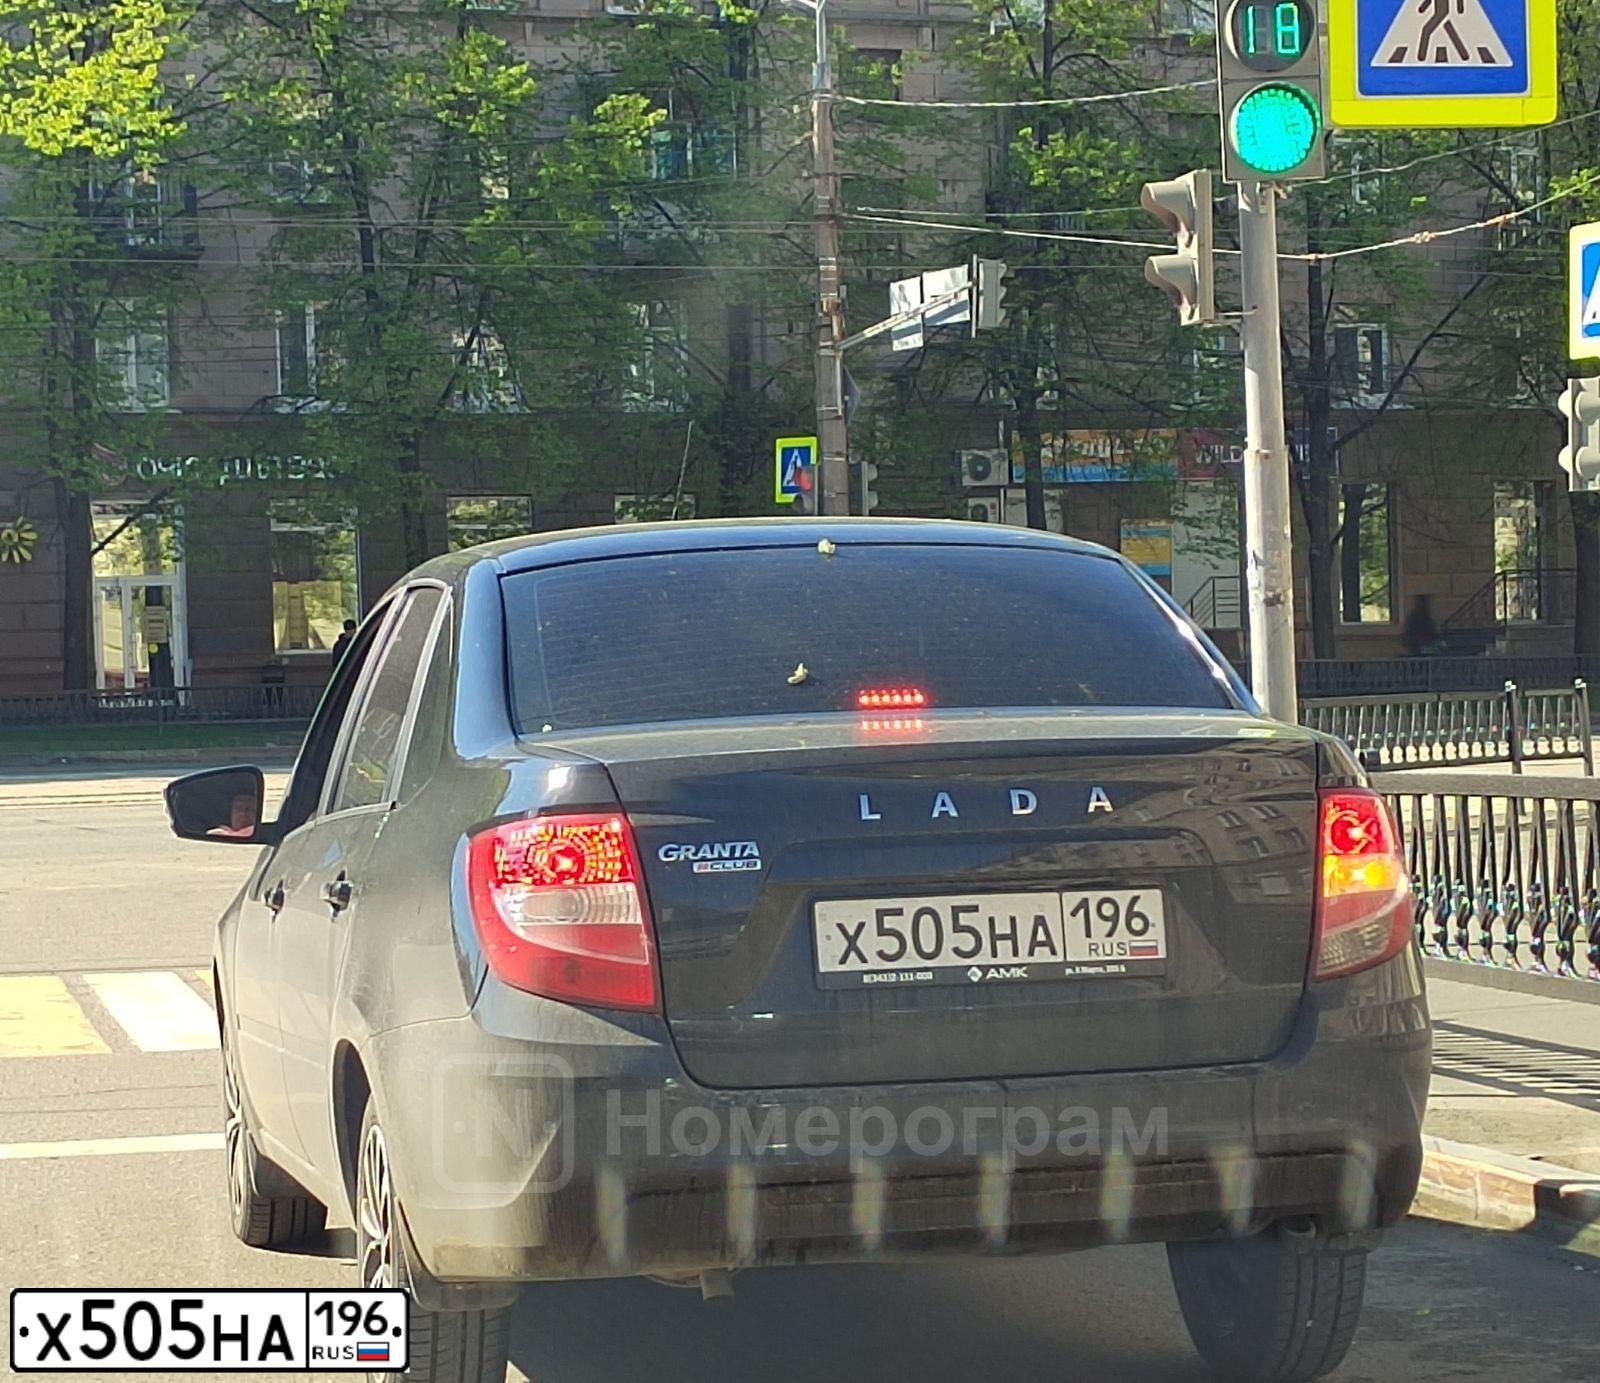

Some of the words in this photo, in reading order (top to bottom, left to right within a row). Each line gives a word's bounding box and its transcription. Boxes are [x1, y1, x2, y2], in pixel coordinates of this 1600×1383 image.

[1247, 3, 1300, 54] 18
[859, 786, 1114, 821] LADA
[658, 841, 760, 862] GRANTA
[1070, 895, 1150, 939] 196
[1088, 942, 1128, 957] RUS
